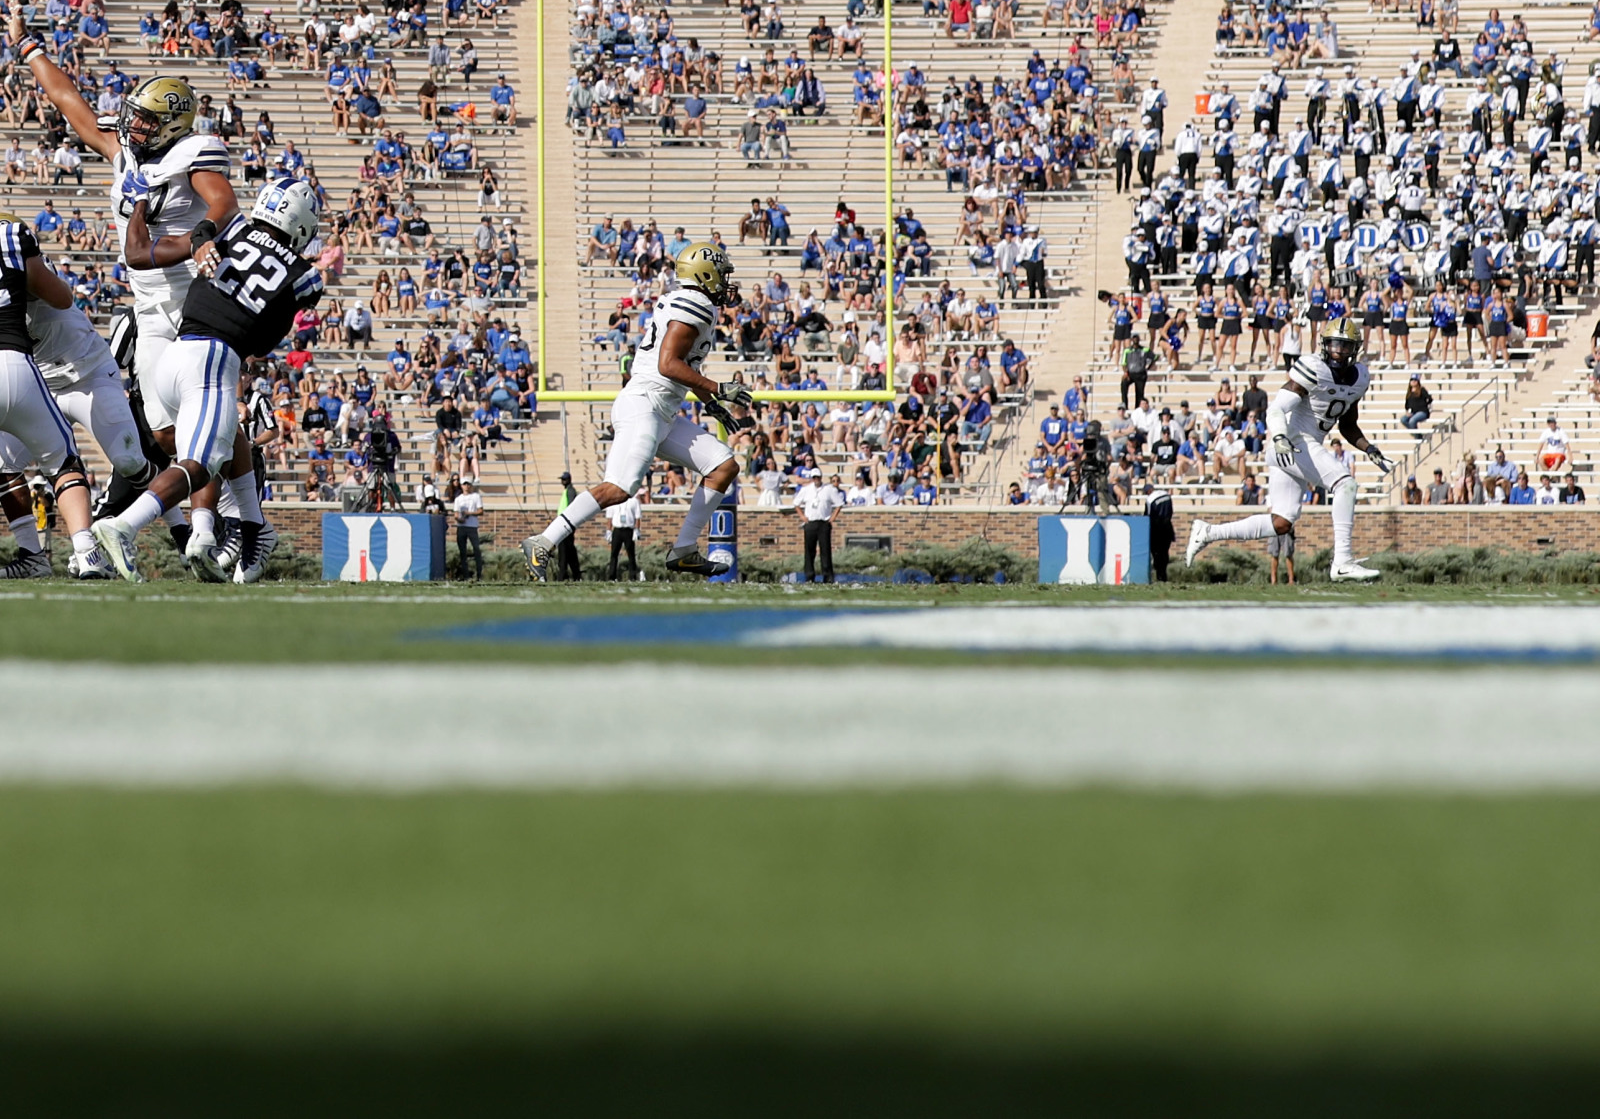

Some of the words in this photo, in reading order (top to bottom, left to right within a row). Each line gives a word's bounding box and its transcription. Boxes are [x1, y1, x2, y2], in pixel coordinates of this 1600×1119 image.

[163, 92, 192, 113] Pitt
[279, 200, 289, 214] 2
[246, 229, 298, 265] BROWN
[699, 247, 724, 264] Pitt
[208, 241, 288, 315] 22
